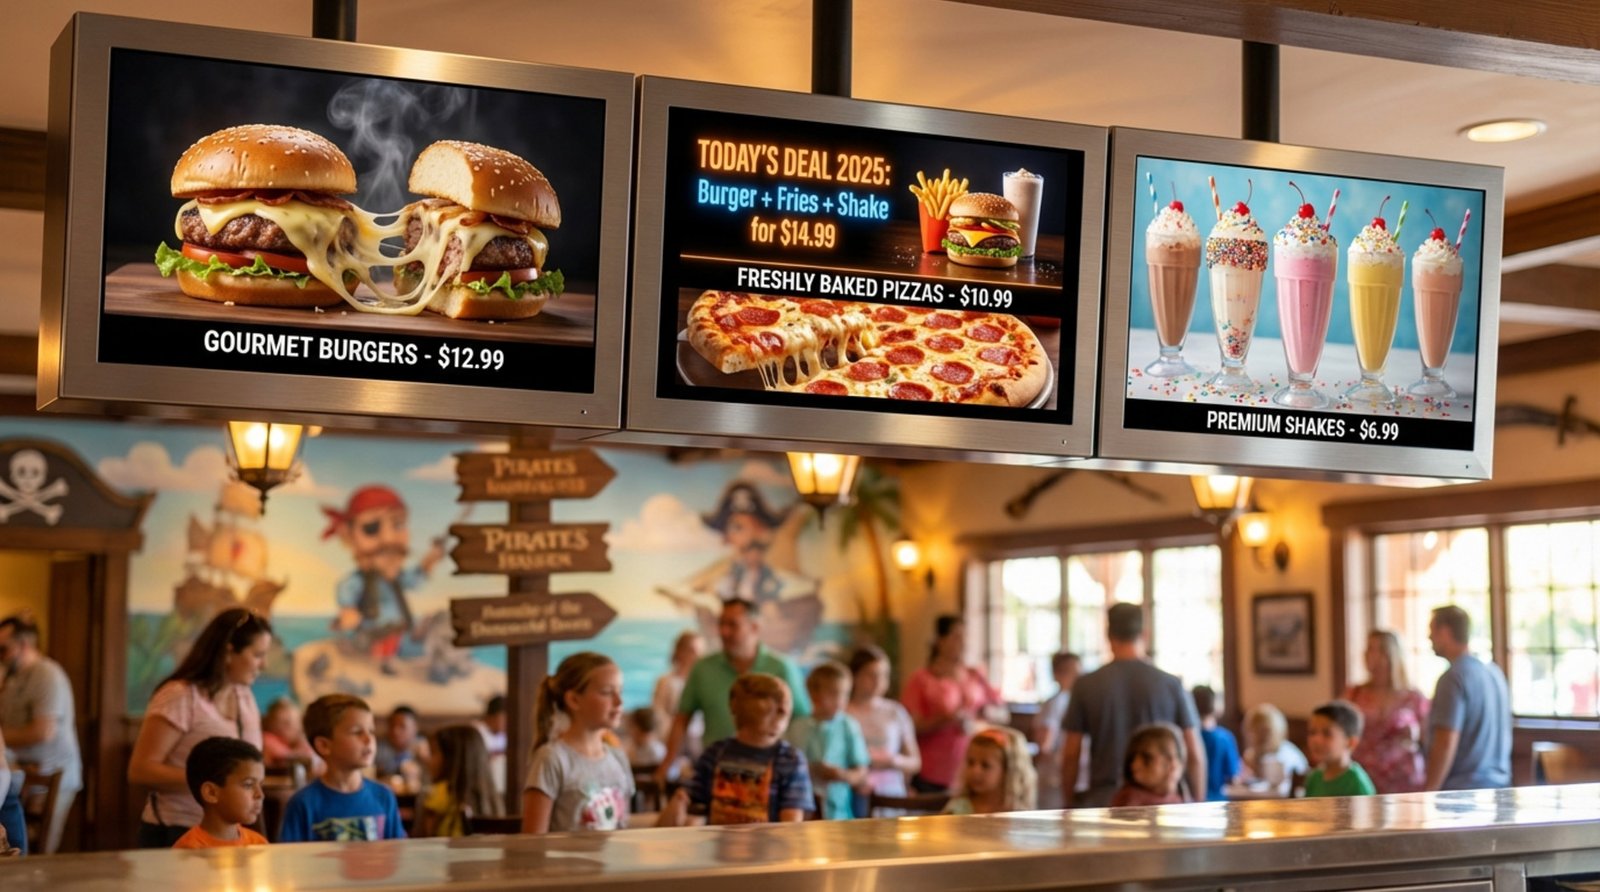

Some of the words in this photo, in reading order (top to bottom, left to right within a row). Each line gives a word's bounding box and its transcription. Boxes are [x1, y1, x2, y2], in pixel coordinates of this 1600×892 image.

[698, 138, 779, 176] TODAY'S
[784, 147, 832, 180] DEAL
[837, 154, 891, 186] 2025:
[698, 179, 757, 212] Burger
[761, 191, 773, 208] +
[777, 186, 819, 214] Fries
[823, 196, 834, 212] +
[838, 192, 889, 220] Shake
[751, 216, 775, 243] for
[780, 220, 836, 248] $14.99
[737, 266, 815, 293] FRESHLY
[820, 274, 878, 297] BAKED
[883, 279, 944, 304] PIZZAS
[960, 284, 1013, 309] $10.99
[204, 329, 313, 358] GOURMET
[319, 337, 418, 365] BURGERS
[438, 343, 505, 371] $12.99
[1207, 410, 1281, 433] PREMIUM
[1285, 416, 1345, 438] SHAKES
[1359, 419, 1399, 441] $6.99
[493, 457, 577, 477] PIRATES
[483, 527, 589, 551] PIRATES
